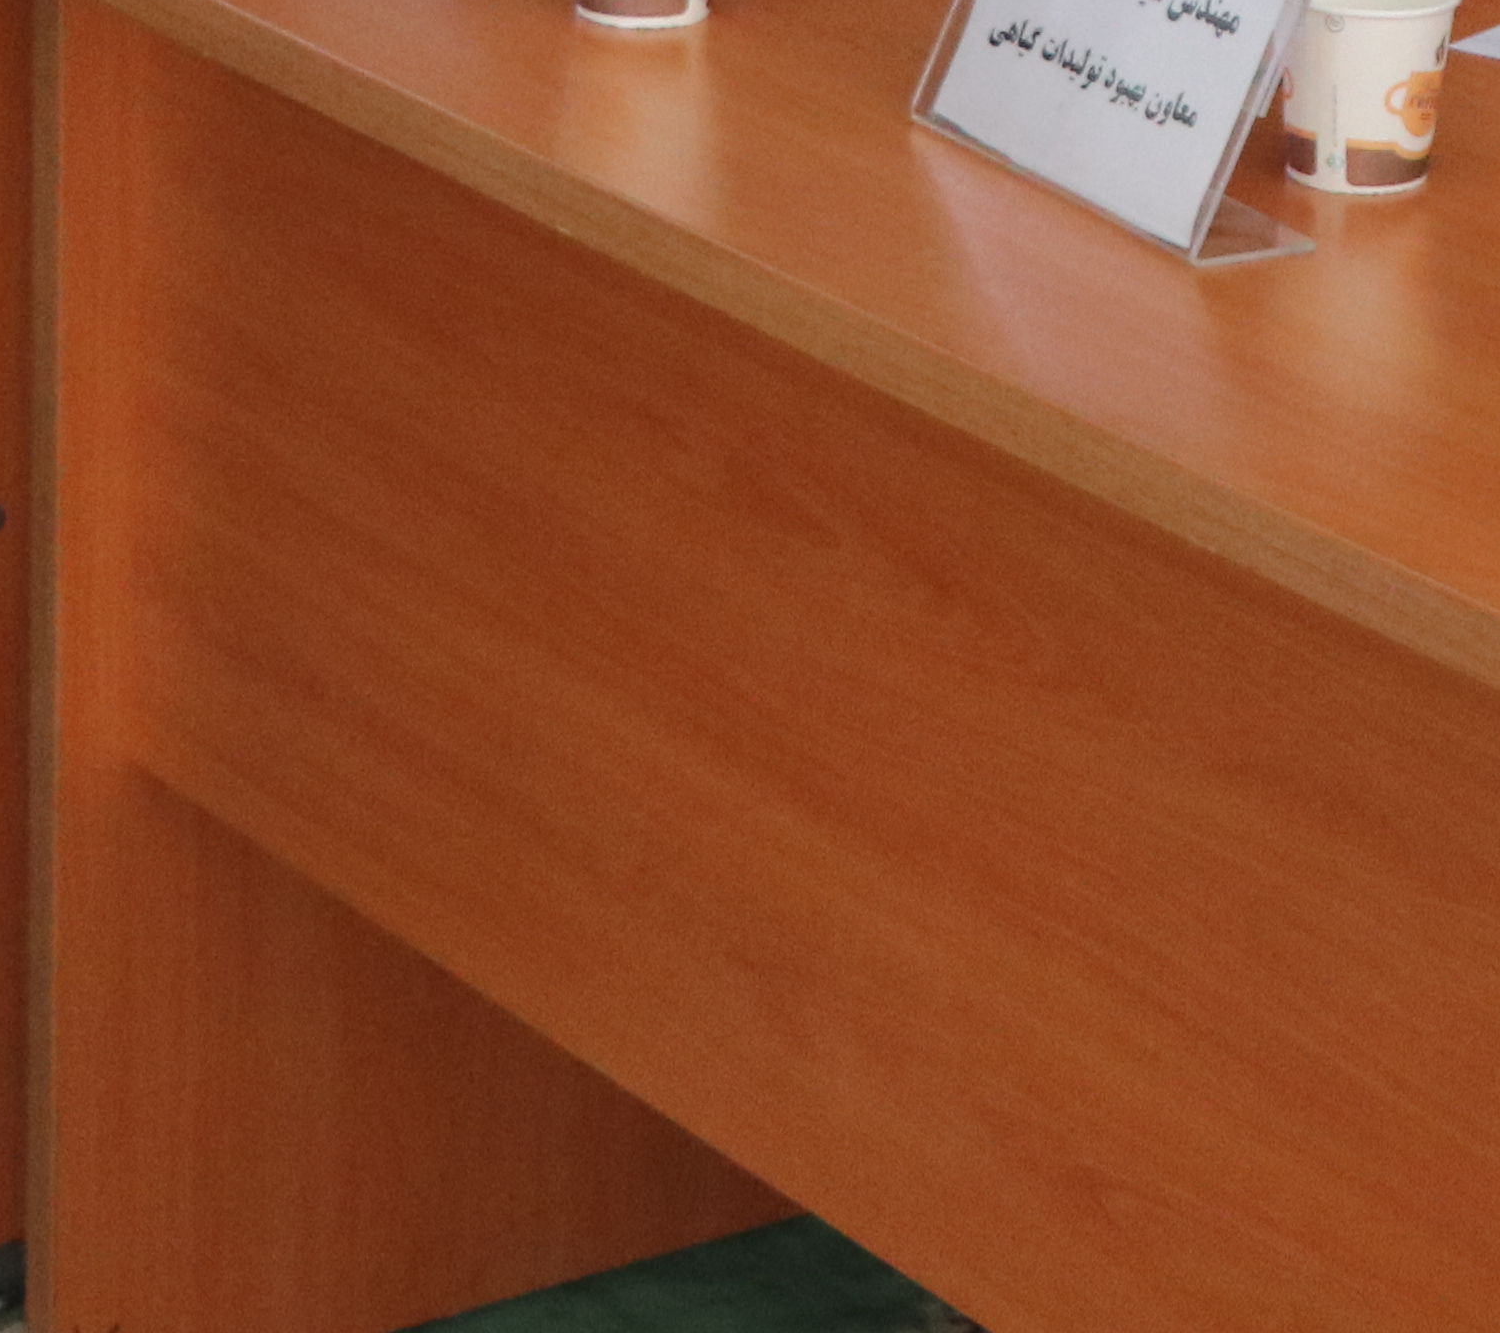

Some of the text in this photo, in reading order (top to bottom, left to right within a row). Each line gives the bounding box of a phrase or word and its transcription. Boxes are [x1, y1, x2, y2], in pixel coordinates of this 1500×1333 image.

[988, 19, 1198, 129] معاون بهبود تولیدات گیاهی
